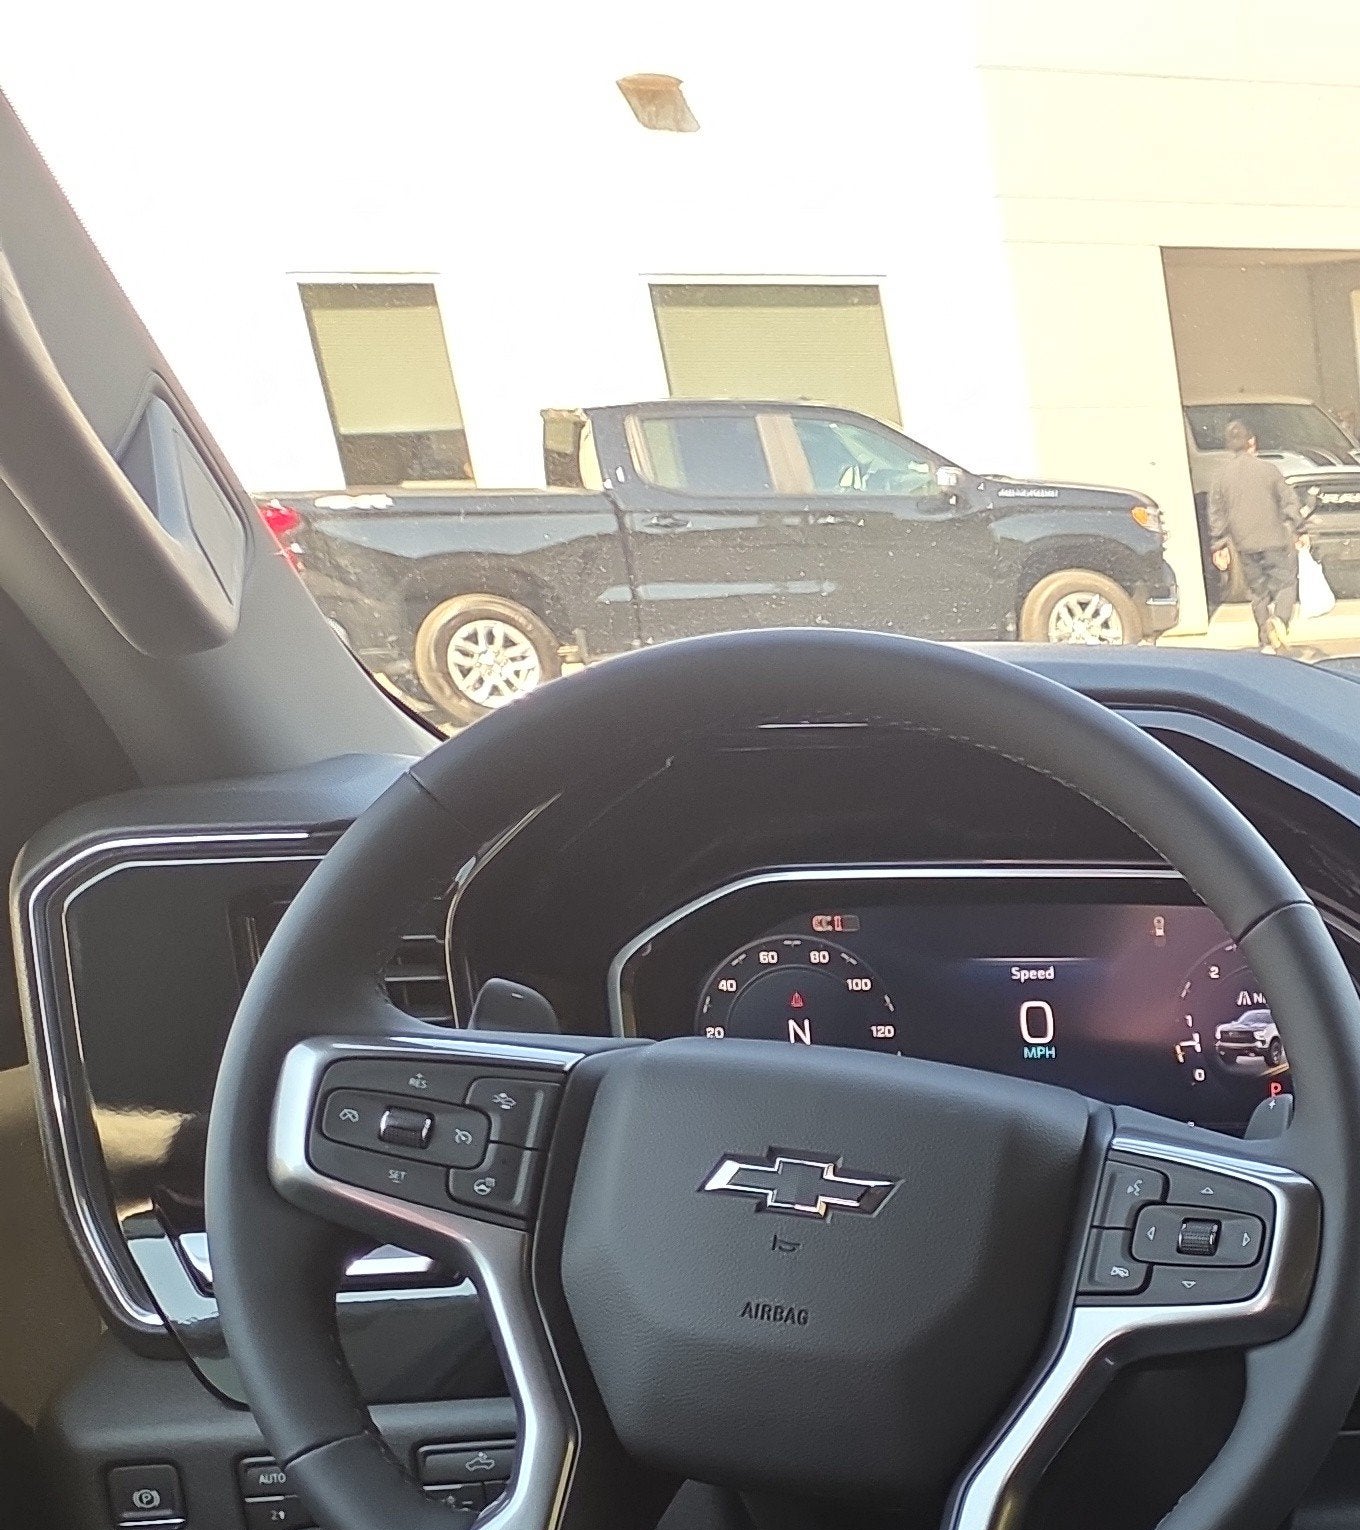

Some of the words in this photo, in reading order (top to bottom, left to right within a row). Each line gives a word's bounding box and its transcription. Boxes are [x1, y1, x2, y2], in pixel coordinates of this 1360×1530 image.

[758, 950, 779, 964] 60
[809, 950, 830, 964] 80
[1011, 965, 1055, 983] Speed
[1209, 965, 1220, 979] 2
[717, 978, 738, 992] 40
[846, 977, 872, 991] 100
[1020, 1000, 1054, 1044] 0
[788, 1018, 812, 1046] N
[870, 1025, 895, 1038] 120
[1023, 1046, 1056, 1059] MPH
[1270, 1081, 1282, 1097] P
[388, 1169, 407, 1180] SET
[740, 1301, 809, 1325] AIRBAG
[259, 1472, 287, 1484] AUTO
